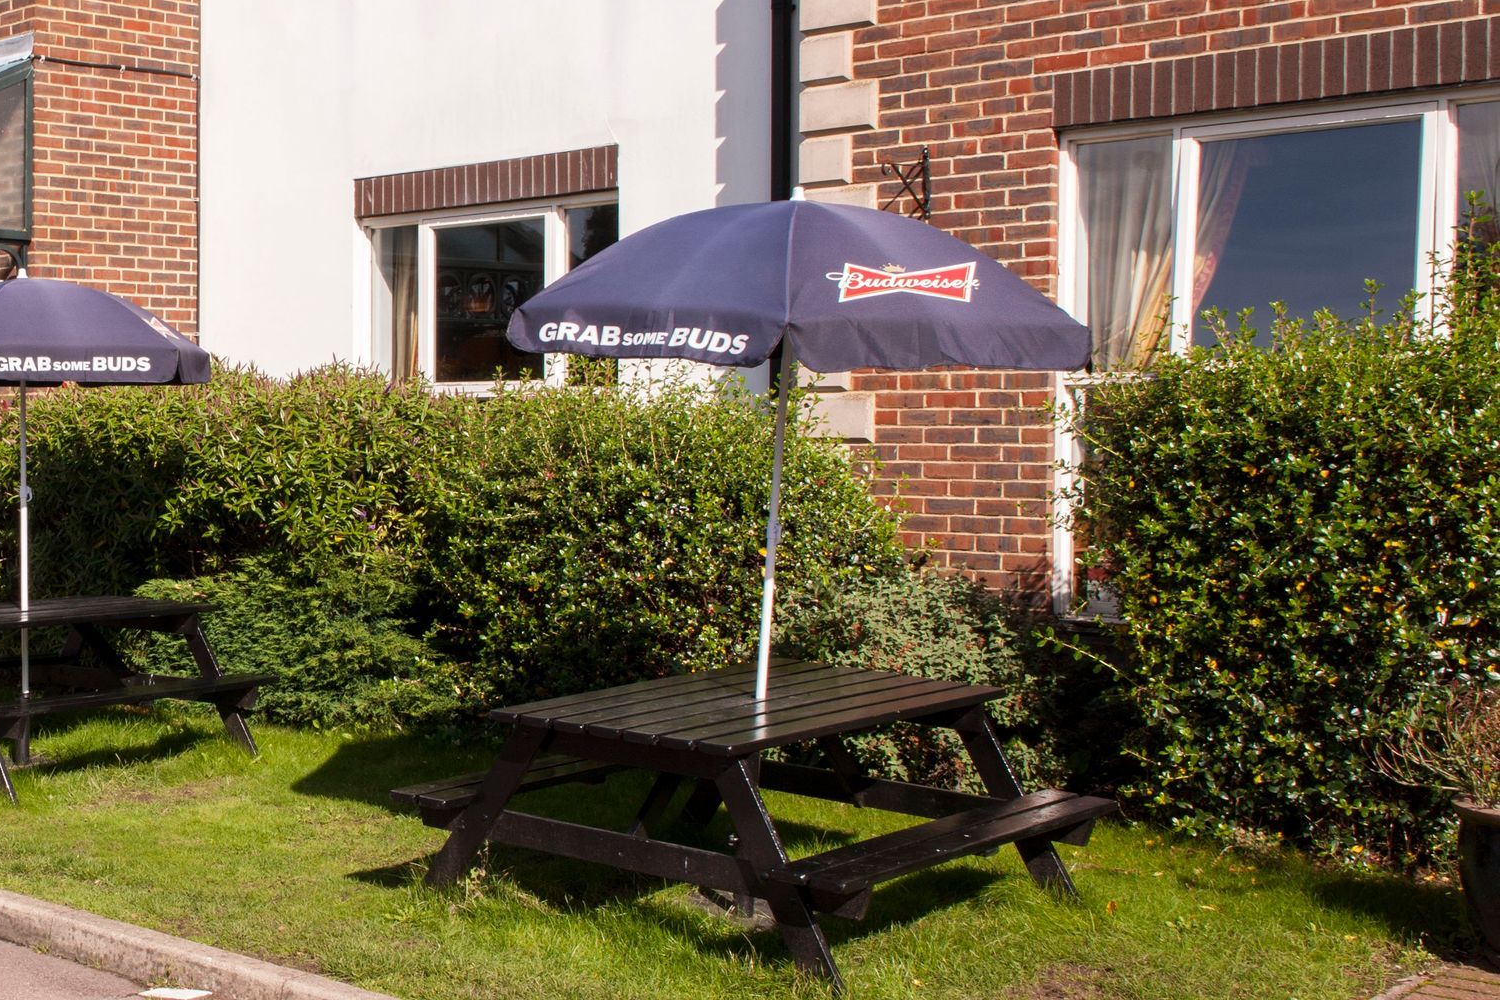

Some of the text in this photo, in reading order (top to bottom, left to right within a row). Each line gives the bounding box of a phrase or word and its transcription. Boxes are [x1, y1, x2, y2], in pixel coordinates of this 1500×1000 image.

[825, 271, 980, 290] Budweiser
[539, 322, 750, 355] GRAB SOME BUDS
[52, 361, 91, 371] SOME
[92, 356, 152, 372] BUDS
